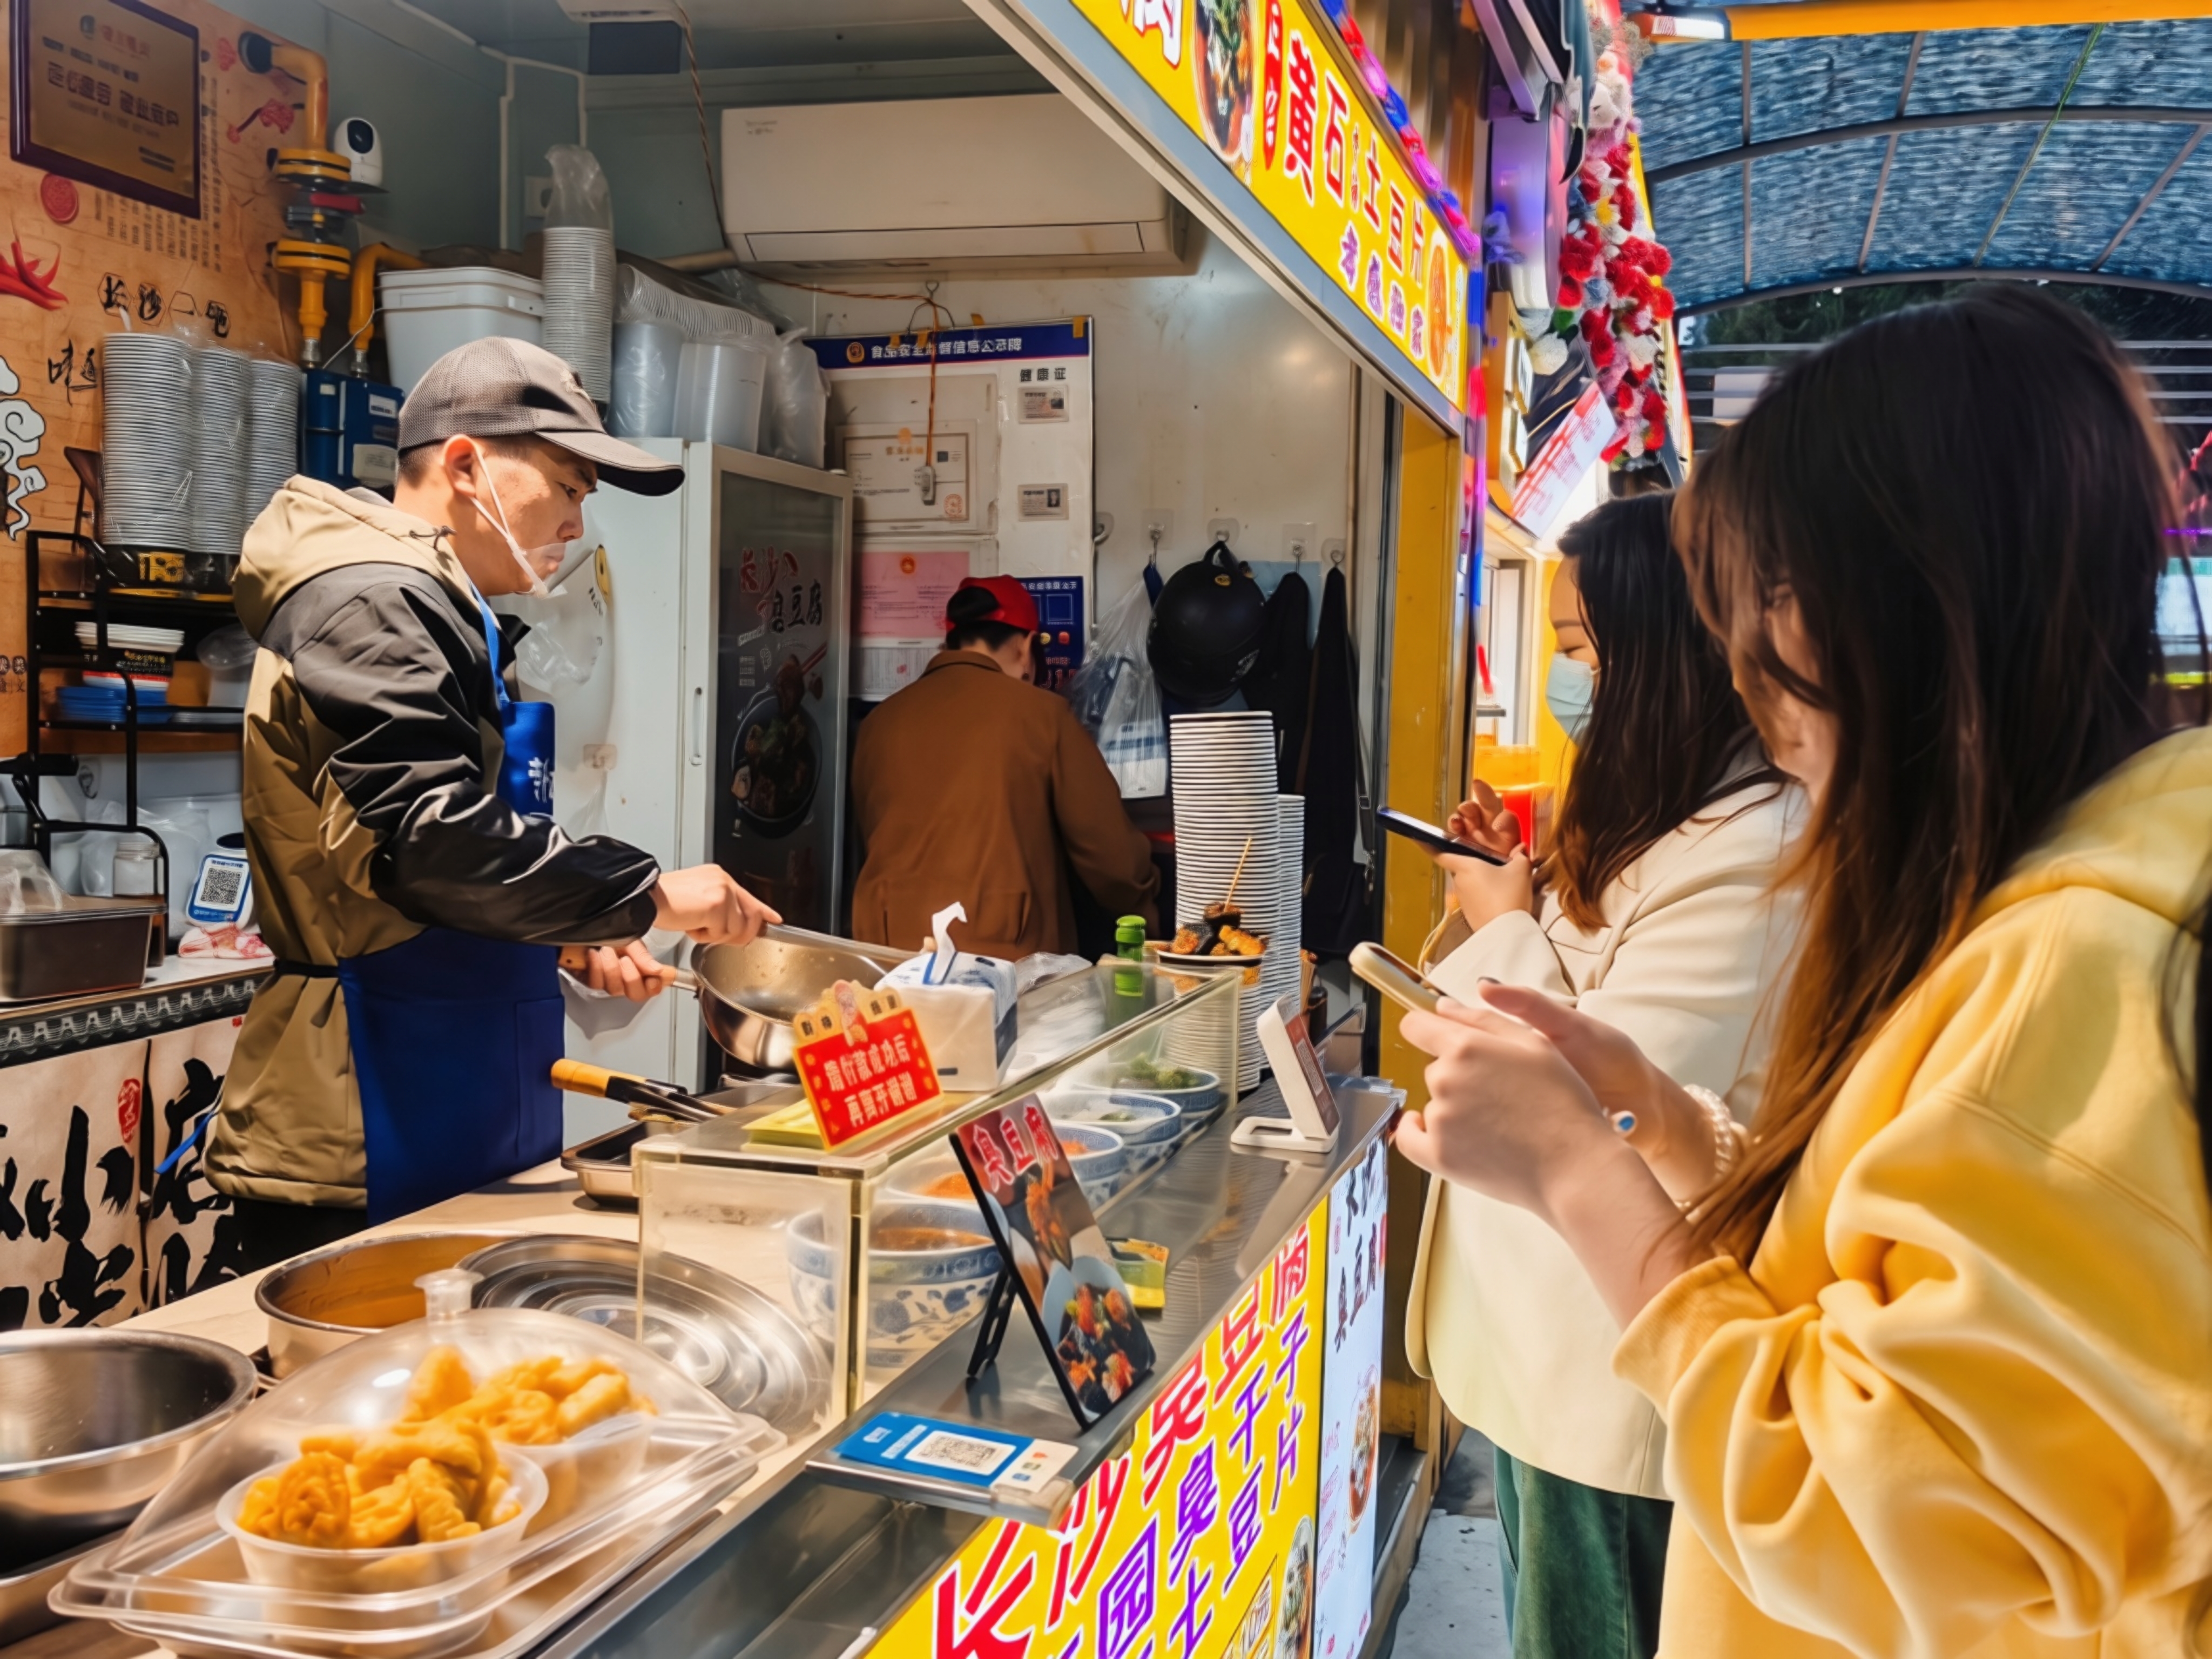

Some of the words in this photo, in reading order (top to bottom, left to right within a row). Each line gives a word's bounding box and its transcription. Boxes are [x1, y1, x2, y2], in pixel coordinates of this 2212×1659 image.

[1284, 32, 1424, 284] 黄石土豆片
[870, 338, 1023, 359] 食品安全监督信息公示牌
[1020, 367, 1066, 382] 健康证
[973, 1104, 1059, 1193] 臭豆腐
[935, 1223, 1309, 1659] 长沙臭豆腐
[1057, 1306, 1309, 1659] 园臭干子
[1126, 1404, 1304, 1659] 土豆片
